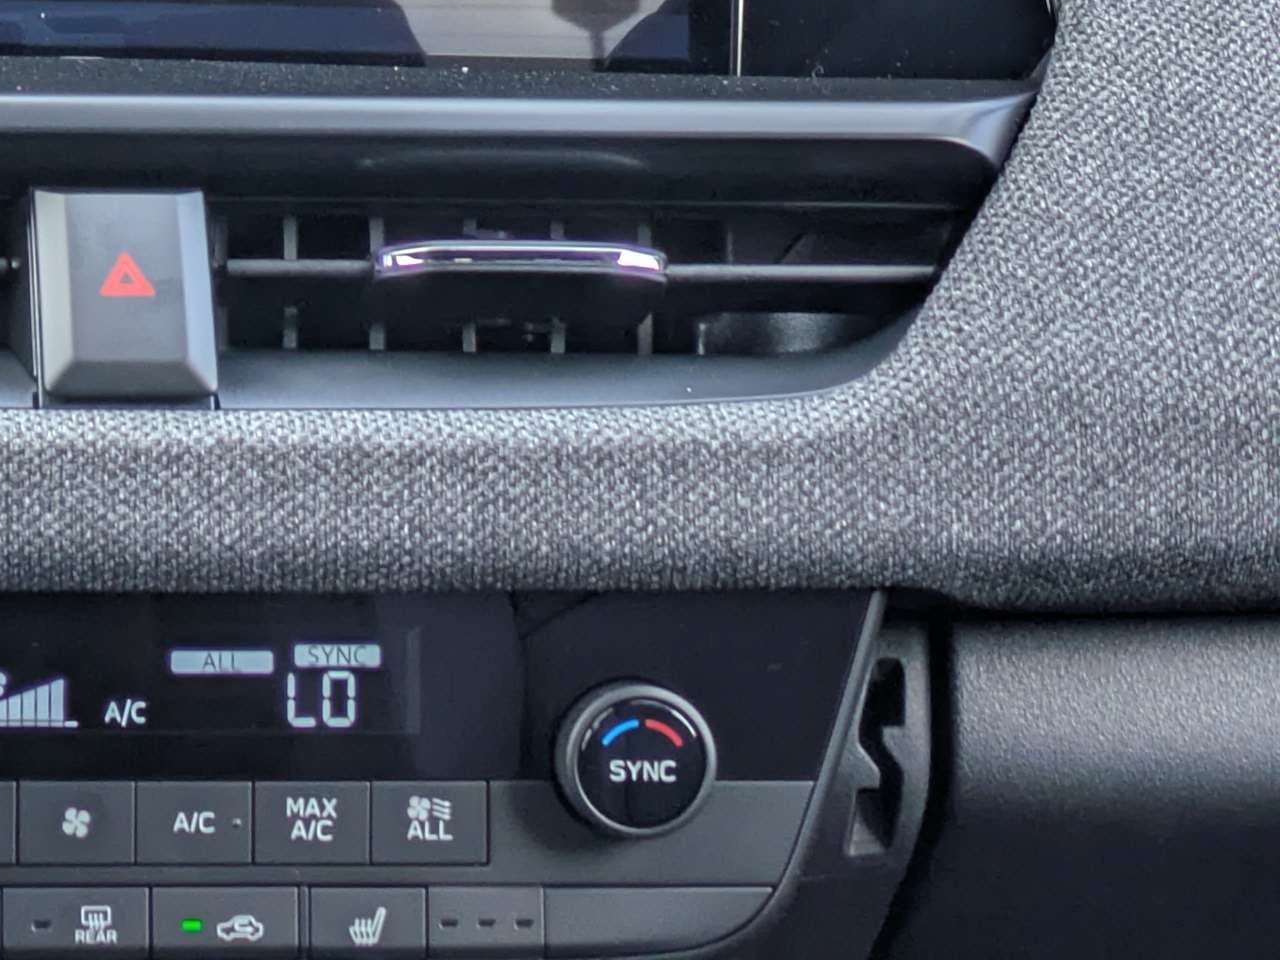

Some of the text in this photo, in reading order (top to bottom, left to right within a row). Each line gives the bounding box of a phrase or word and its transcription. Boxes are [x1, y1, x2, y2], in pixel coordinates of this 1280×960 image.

[201, 651, 240, 673] ALL
[307, 645, 367, 666] SYNC
[104, 698, 147, 728] A/C
[609, 759, 677, 783] SYNC
[286, 797, 337, 818] MAX
[173, 811, 215, 834] A/C
[290, 819, 333, 842] A/C
[407, 819, 453, 841] ALL
[74, 928, 119, 945] REAR
